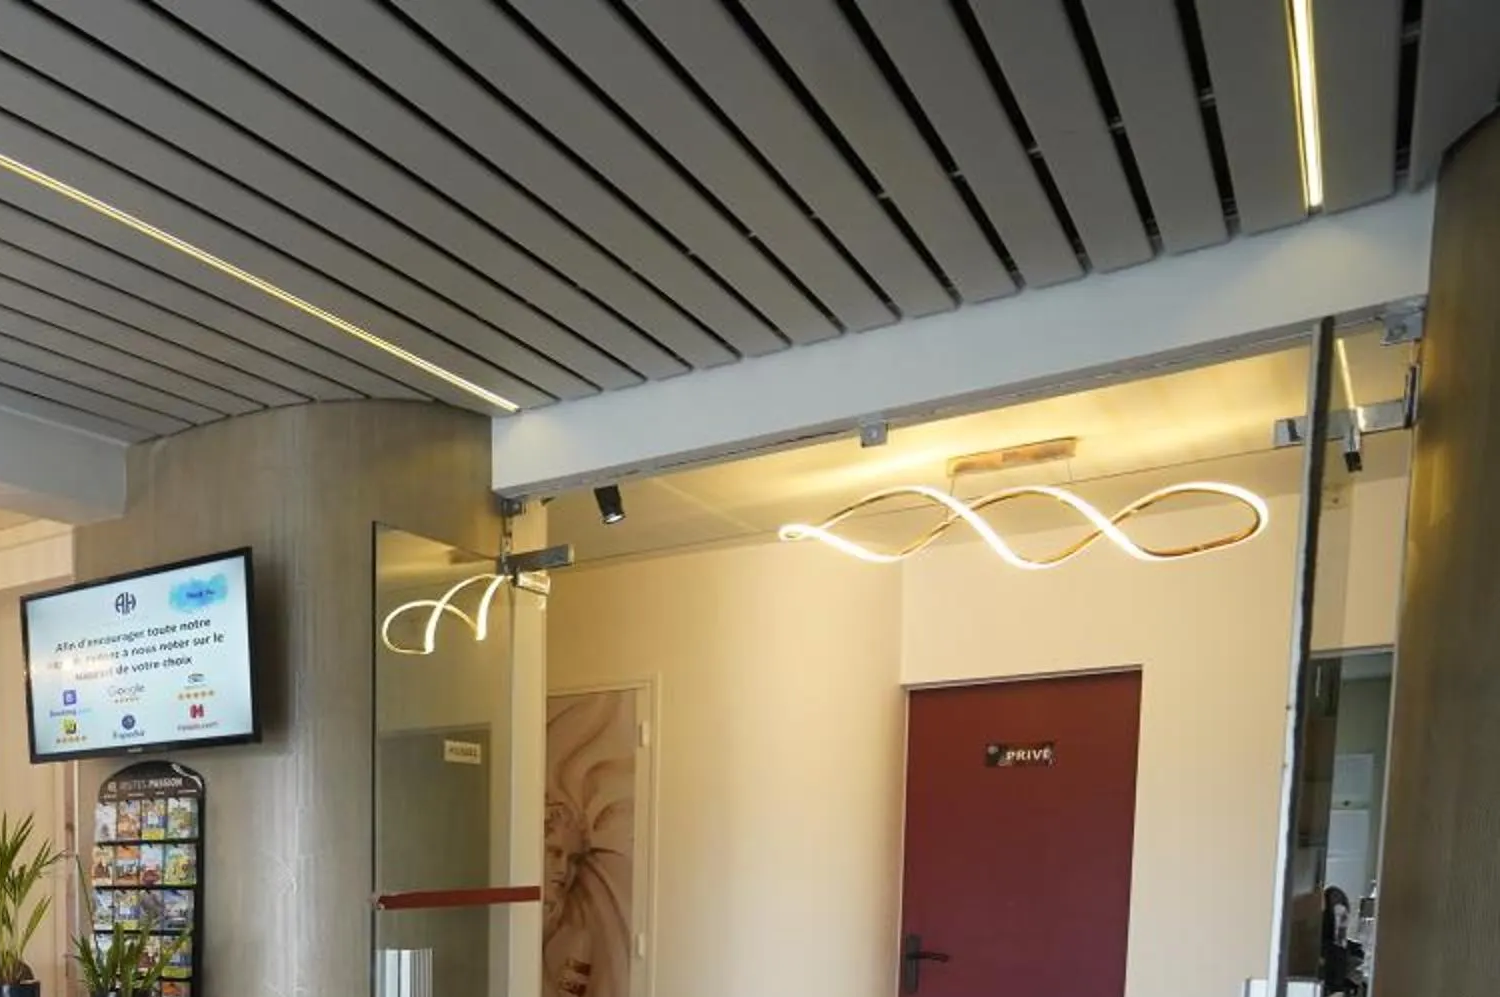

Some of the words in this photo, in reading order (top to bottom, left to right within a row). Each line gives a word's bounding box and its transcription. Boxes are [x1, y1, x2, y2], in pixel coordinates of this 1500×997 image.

[147, 623, 178, 637] toute
[179, 618, 211, 632] notre
[131, 645, 157, 657] nous
[159, 637, 191, 651] noter
[192, 634, 211, 646] sur
[213, 632, 225, 644] le
[115, 664, 129, 676] de
[131, 658, 160, 673] votre
[162, 655, 193, 668] choix
